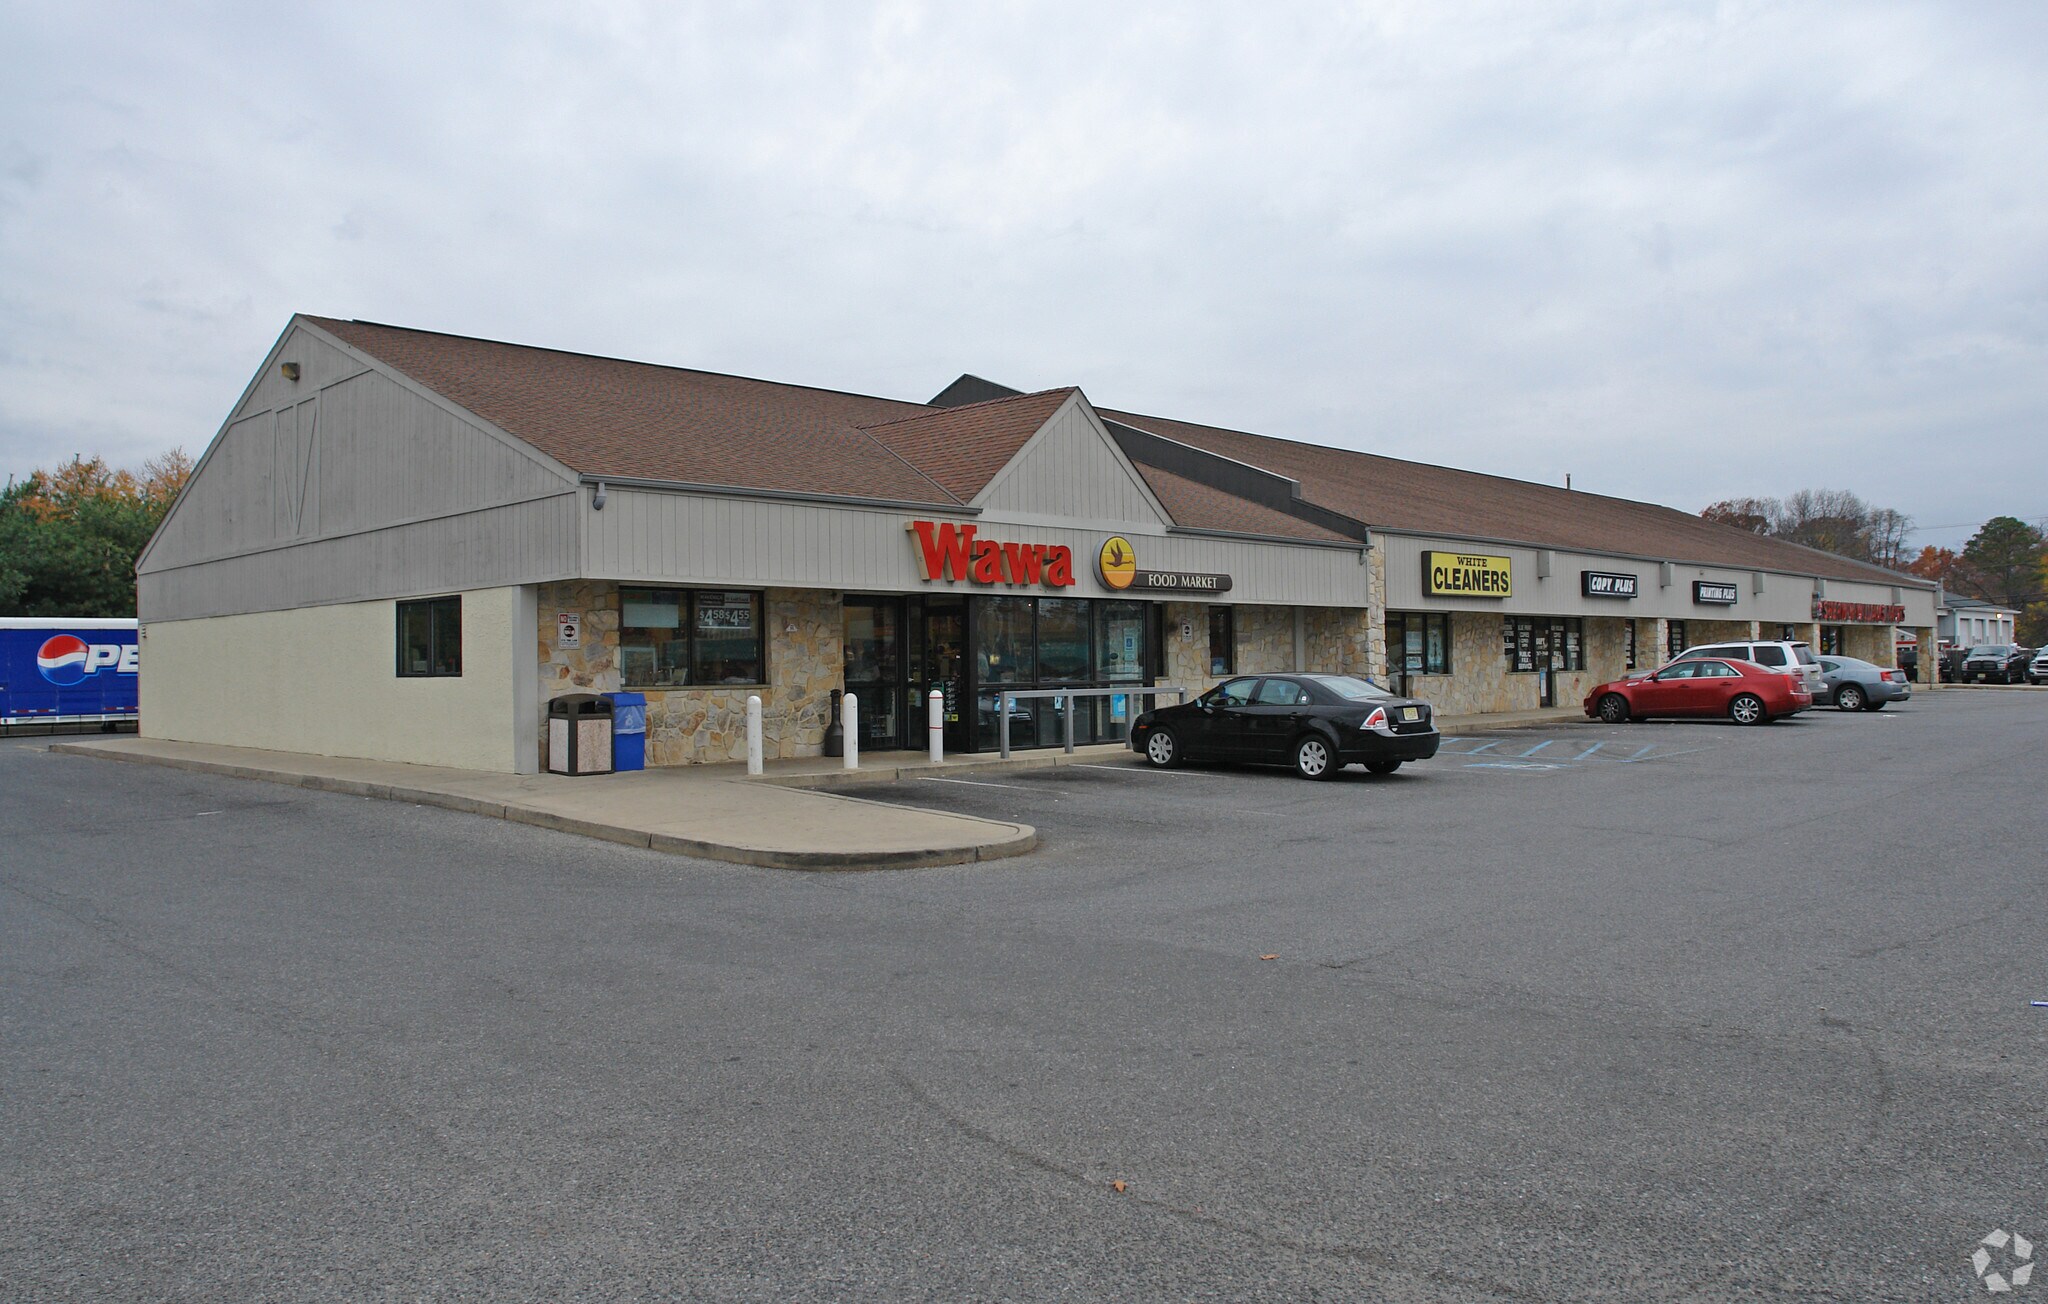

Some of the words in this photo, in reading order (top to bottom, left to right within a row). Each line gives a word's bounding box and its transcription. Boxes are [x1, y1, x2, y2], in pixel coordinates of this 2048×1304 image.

[912, 520, 1076, 587] Wawa
[1456, 556, 1488, 568] WHITE
[1148, 573, 1177, 587] FOOD
[1181, 575, 1218, 589] MARKET
[1433, 566, 1510, 593] CLEANERS
[1591, 576, 1613, 592] COPY
[1614, 578, 1635, 593] PLUS
[1699, 586, 1723, 599] PRINTING
[1722, 587, 1736, 600] PLUS
[84, 643, 139, 673] PE
